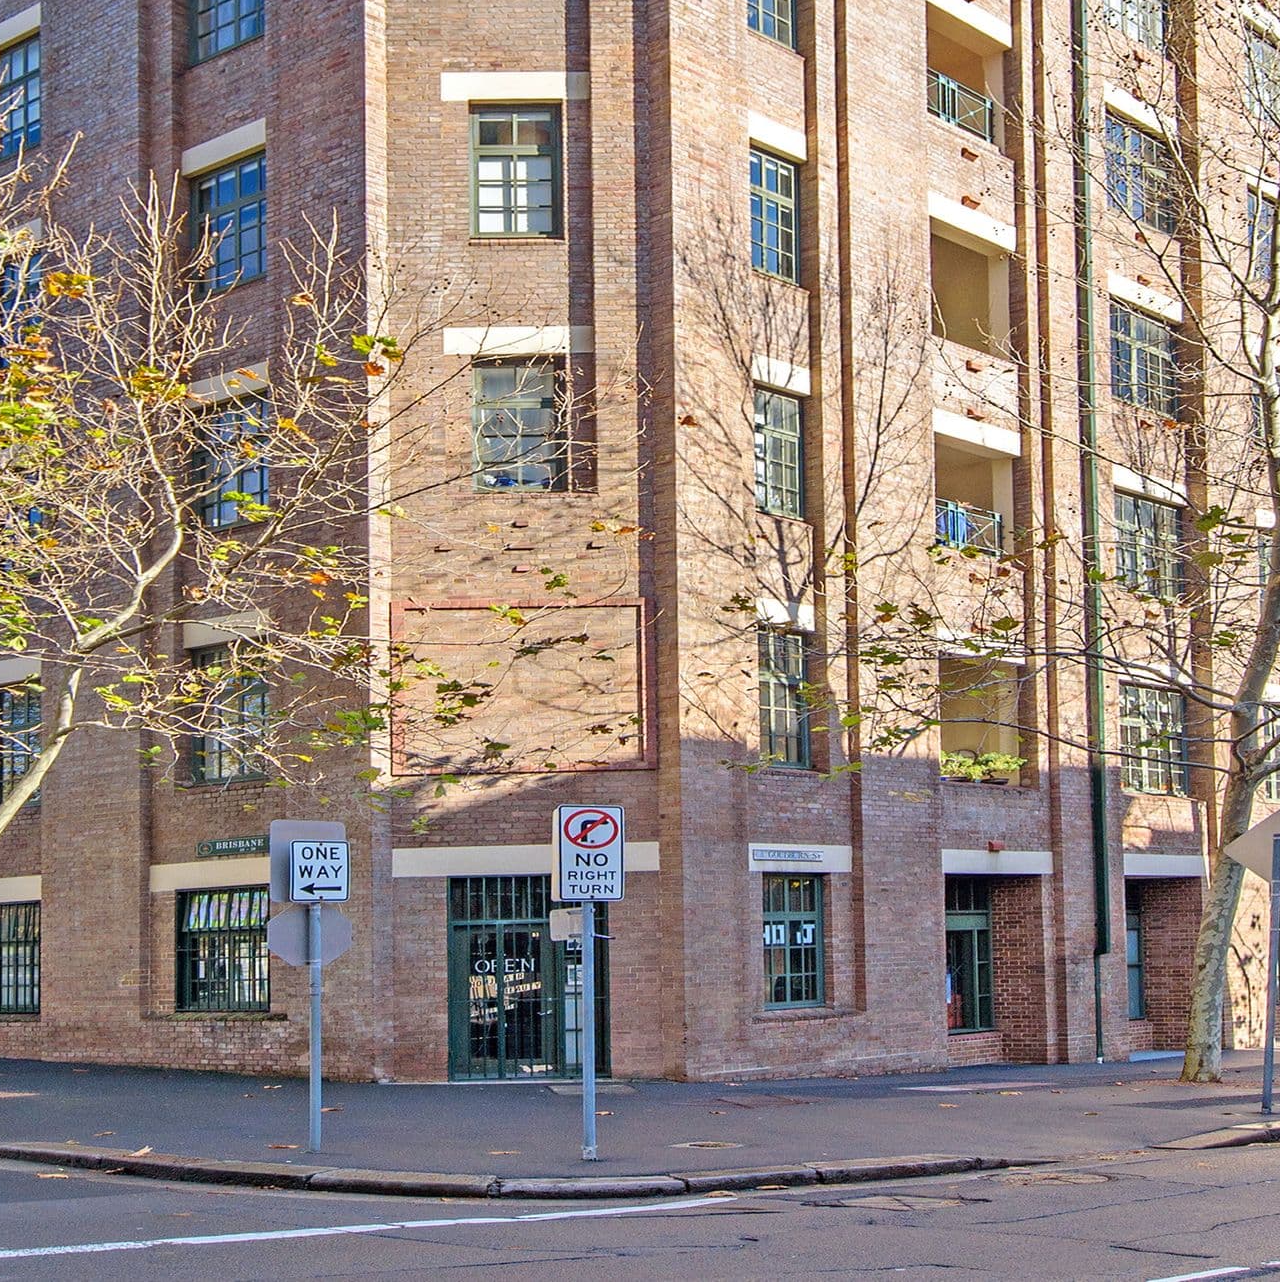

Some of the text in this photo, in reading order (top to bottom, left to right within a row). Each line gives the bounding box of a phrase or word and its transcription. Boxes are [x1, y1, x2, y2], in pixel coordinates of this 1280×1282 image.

[215, 838, 264, 850] BRISBANE
[301, 846, 341, 861] ONE
[575, 853, 609, 867] NO
[298, 865, 343, 879] WAY
[567, 870, 617, 881] RIGHT
[568, 884, 615, 895] TURN
[474, 958, 536, 973] OPEN
